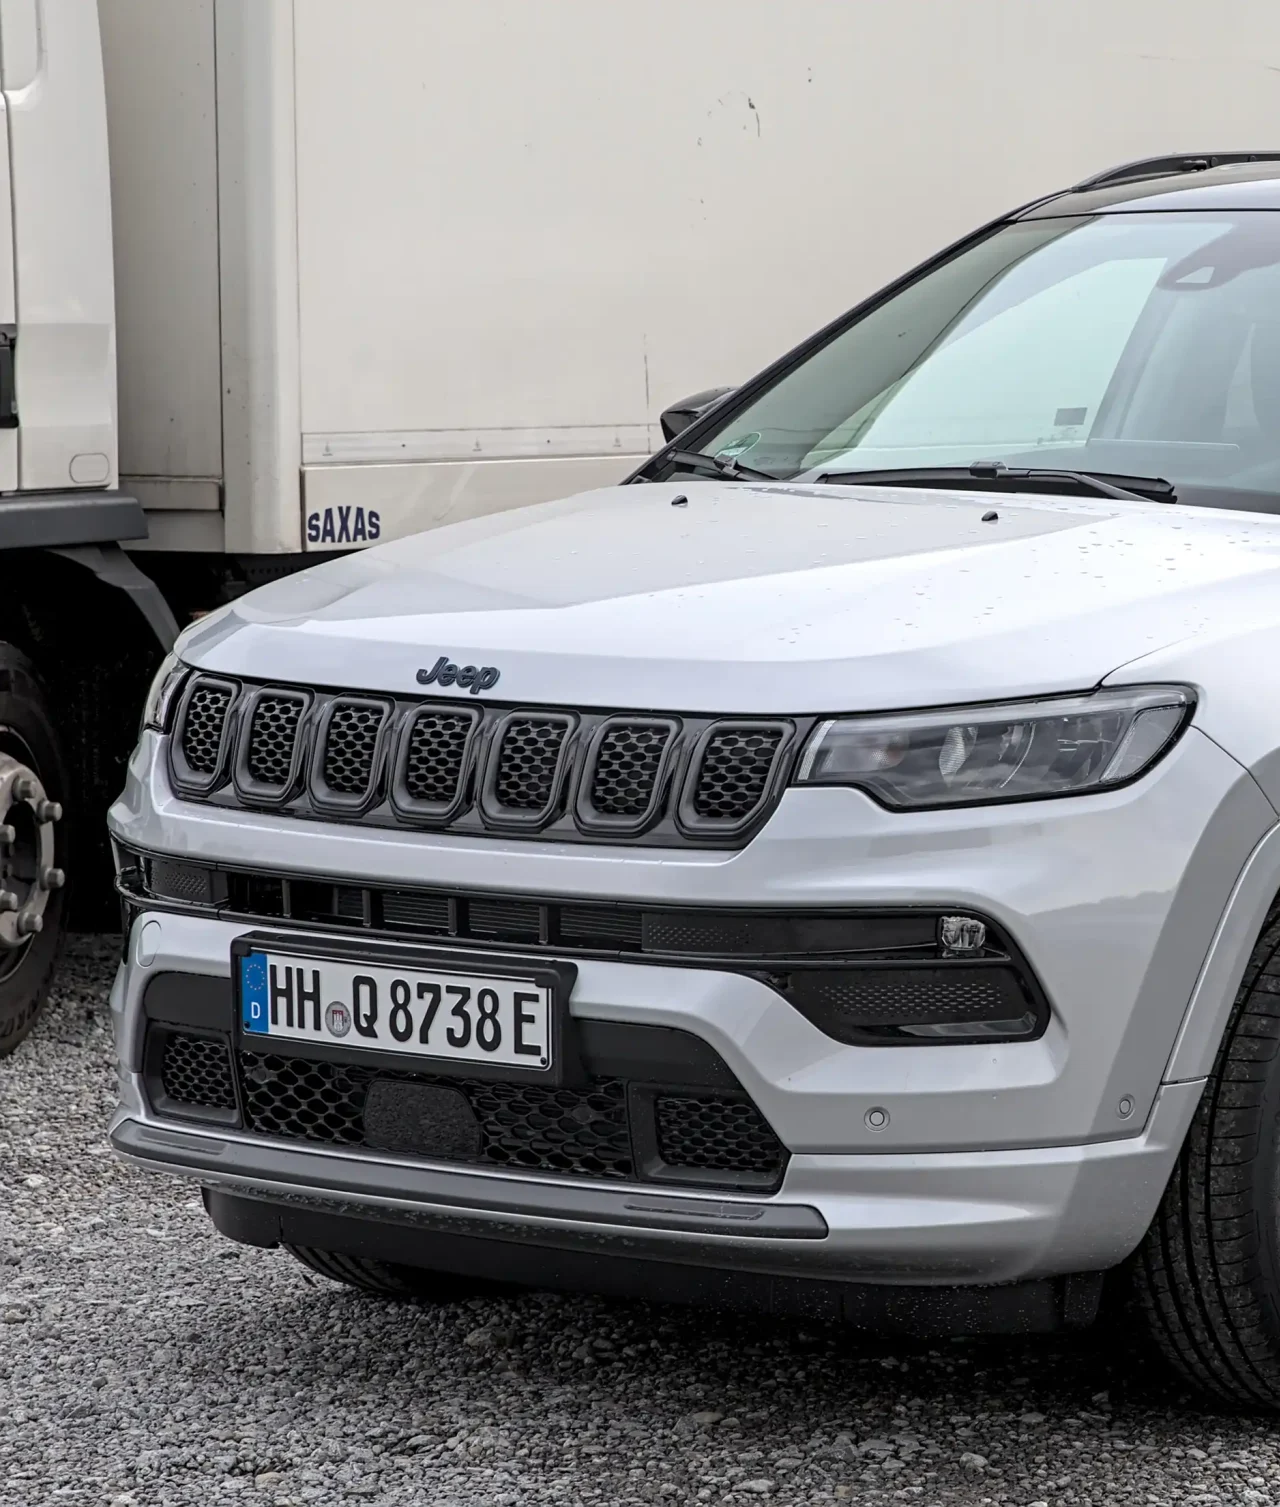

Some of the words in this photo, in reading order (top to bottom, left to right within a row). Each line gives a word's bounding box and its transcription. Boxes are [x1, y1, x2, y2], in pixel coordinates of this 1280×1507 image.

[307, 505, 380, 543] SAXAS
[416, 656, 501, 695] Jeep
[251, 1002, 261, 1019] D
[269, 964, 321, 1031] HH
